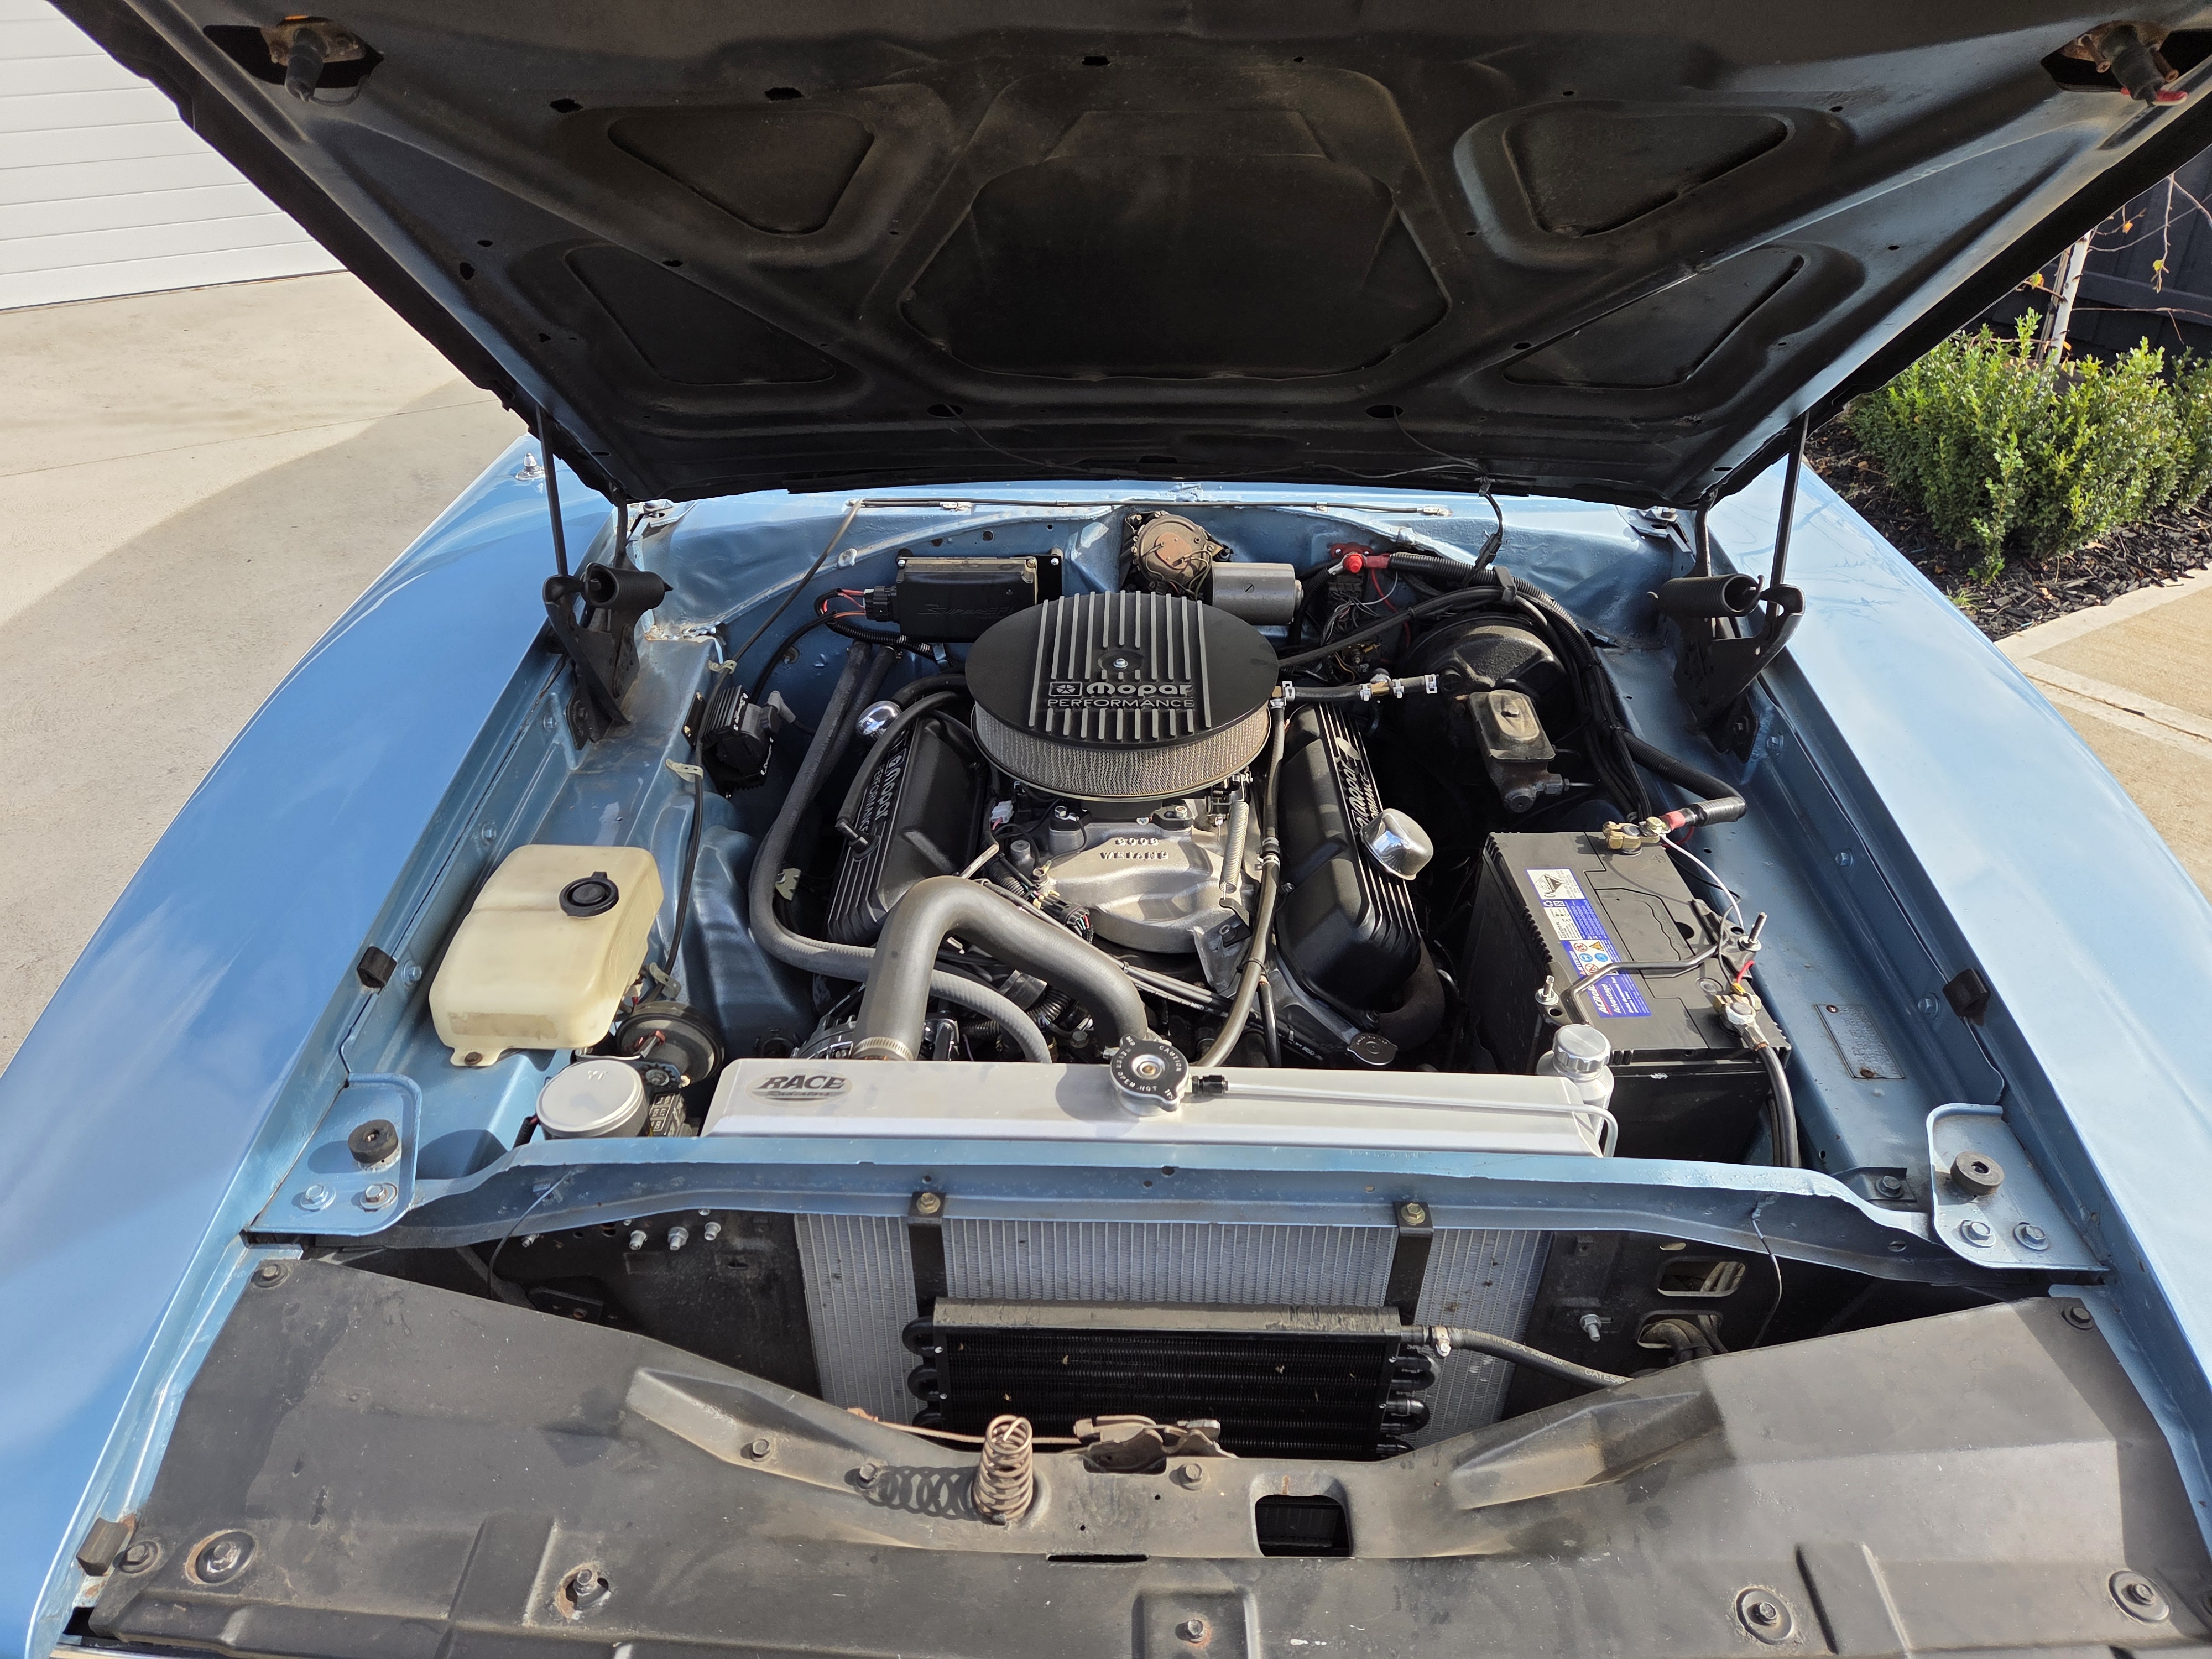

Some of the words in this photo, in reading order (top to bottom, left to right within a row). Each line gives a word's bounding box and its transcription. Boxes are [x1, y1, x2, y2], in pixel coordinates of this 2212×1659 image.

[1047, 698, 1195, 708] PERFORMANCE
[1360, 773, 1379, 820] ORMANCE
[1099, 850, 1170, 860] WEIAND
[1587, 983, 1609, 1014] ACDelc
[1601, 983, 1623, 1014] Advantage
[1159, 1045, 1182, 1072] CAUTION
[755, 1074, 847, 1090] RACE
[1117, 1071, 1136, 1088] OPEN
